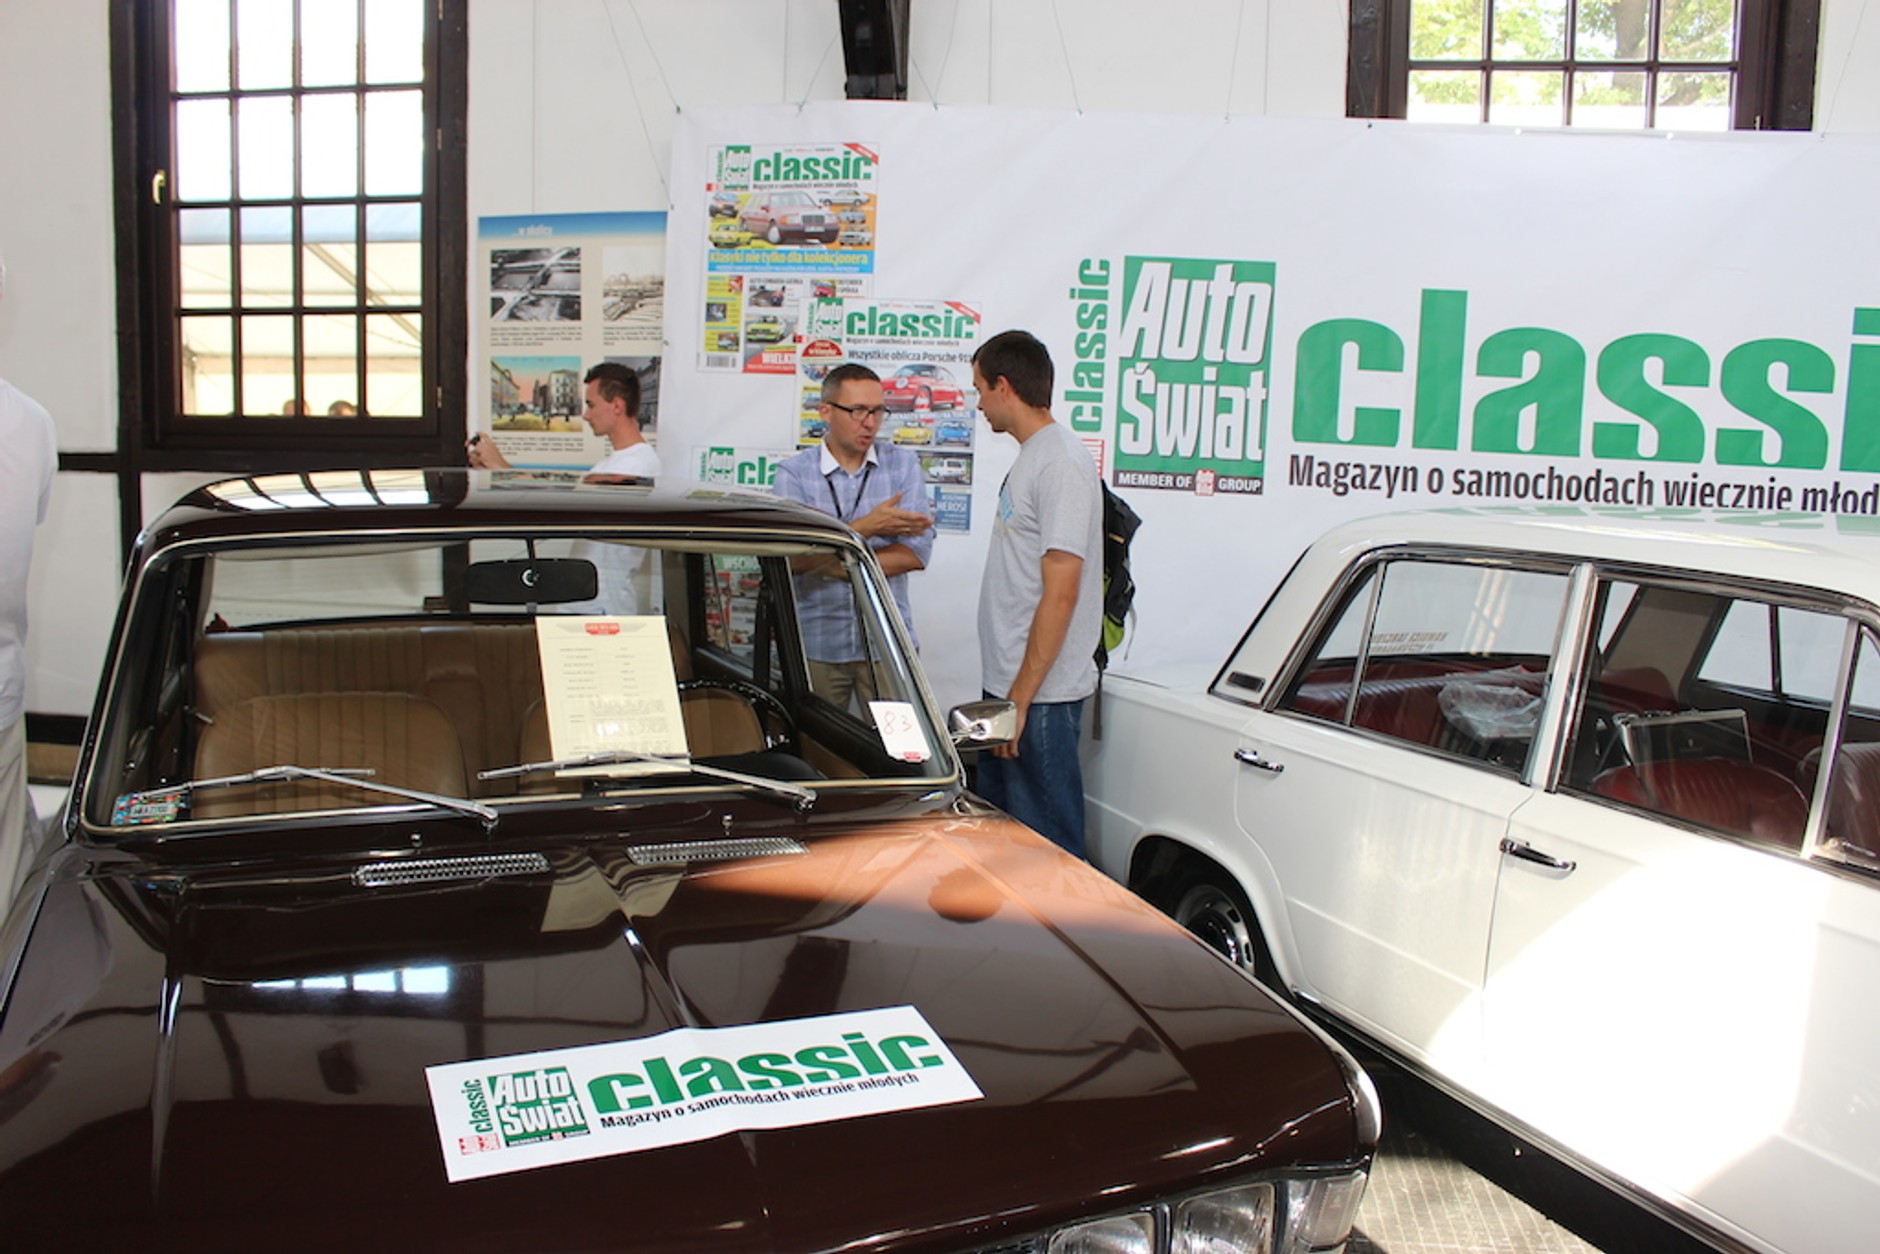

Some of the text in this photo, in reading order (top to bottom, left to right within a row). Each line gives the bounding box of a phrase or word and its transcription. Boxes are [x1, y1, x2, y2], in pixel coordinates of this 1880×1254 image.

[753, 151, 872, 181] classic
[710, 251, 868, 265] Klasyki nie tylko dla kolekcjonera
[846, 306, 974, 339] classic
[1119, 262, 1272, 363] Auto
[848, 350, 888, 362] Wszystkie
[892, 350, 921, 361] oblicza
[923, 352, 956, 362] Porsche
[1065, 259, 1110, 432] classic
[1292, 288, 1880, 472] classi
[1119, 362, 1267, 461] Świat
[1118, 472, 1173, 488] MEMBER
[1176, 475, 1192, 488] OF
[1218, 478, 1262, 492] GROUP
[1289, 454, 1418, 498] Magazyn
[1427, 467, 1444, 494] o
[1452, 465, 1654, 505] samochodach
[1664, 472, 1793, 510] wiecznie
[494, 1069, 572, 1106] Auto
[587, 1032, 944, 1114] classic
[462, 1079, 494, 1133] classic
[500, 1097, 584, 1136] Świat
[600, 1072, 920, 1128] Magazyn o samochodach wiecznie młodych
